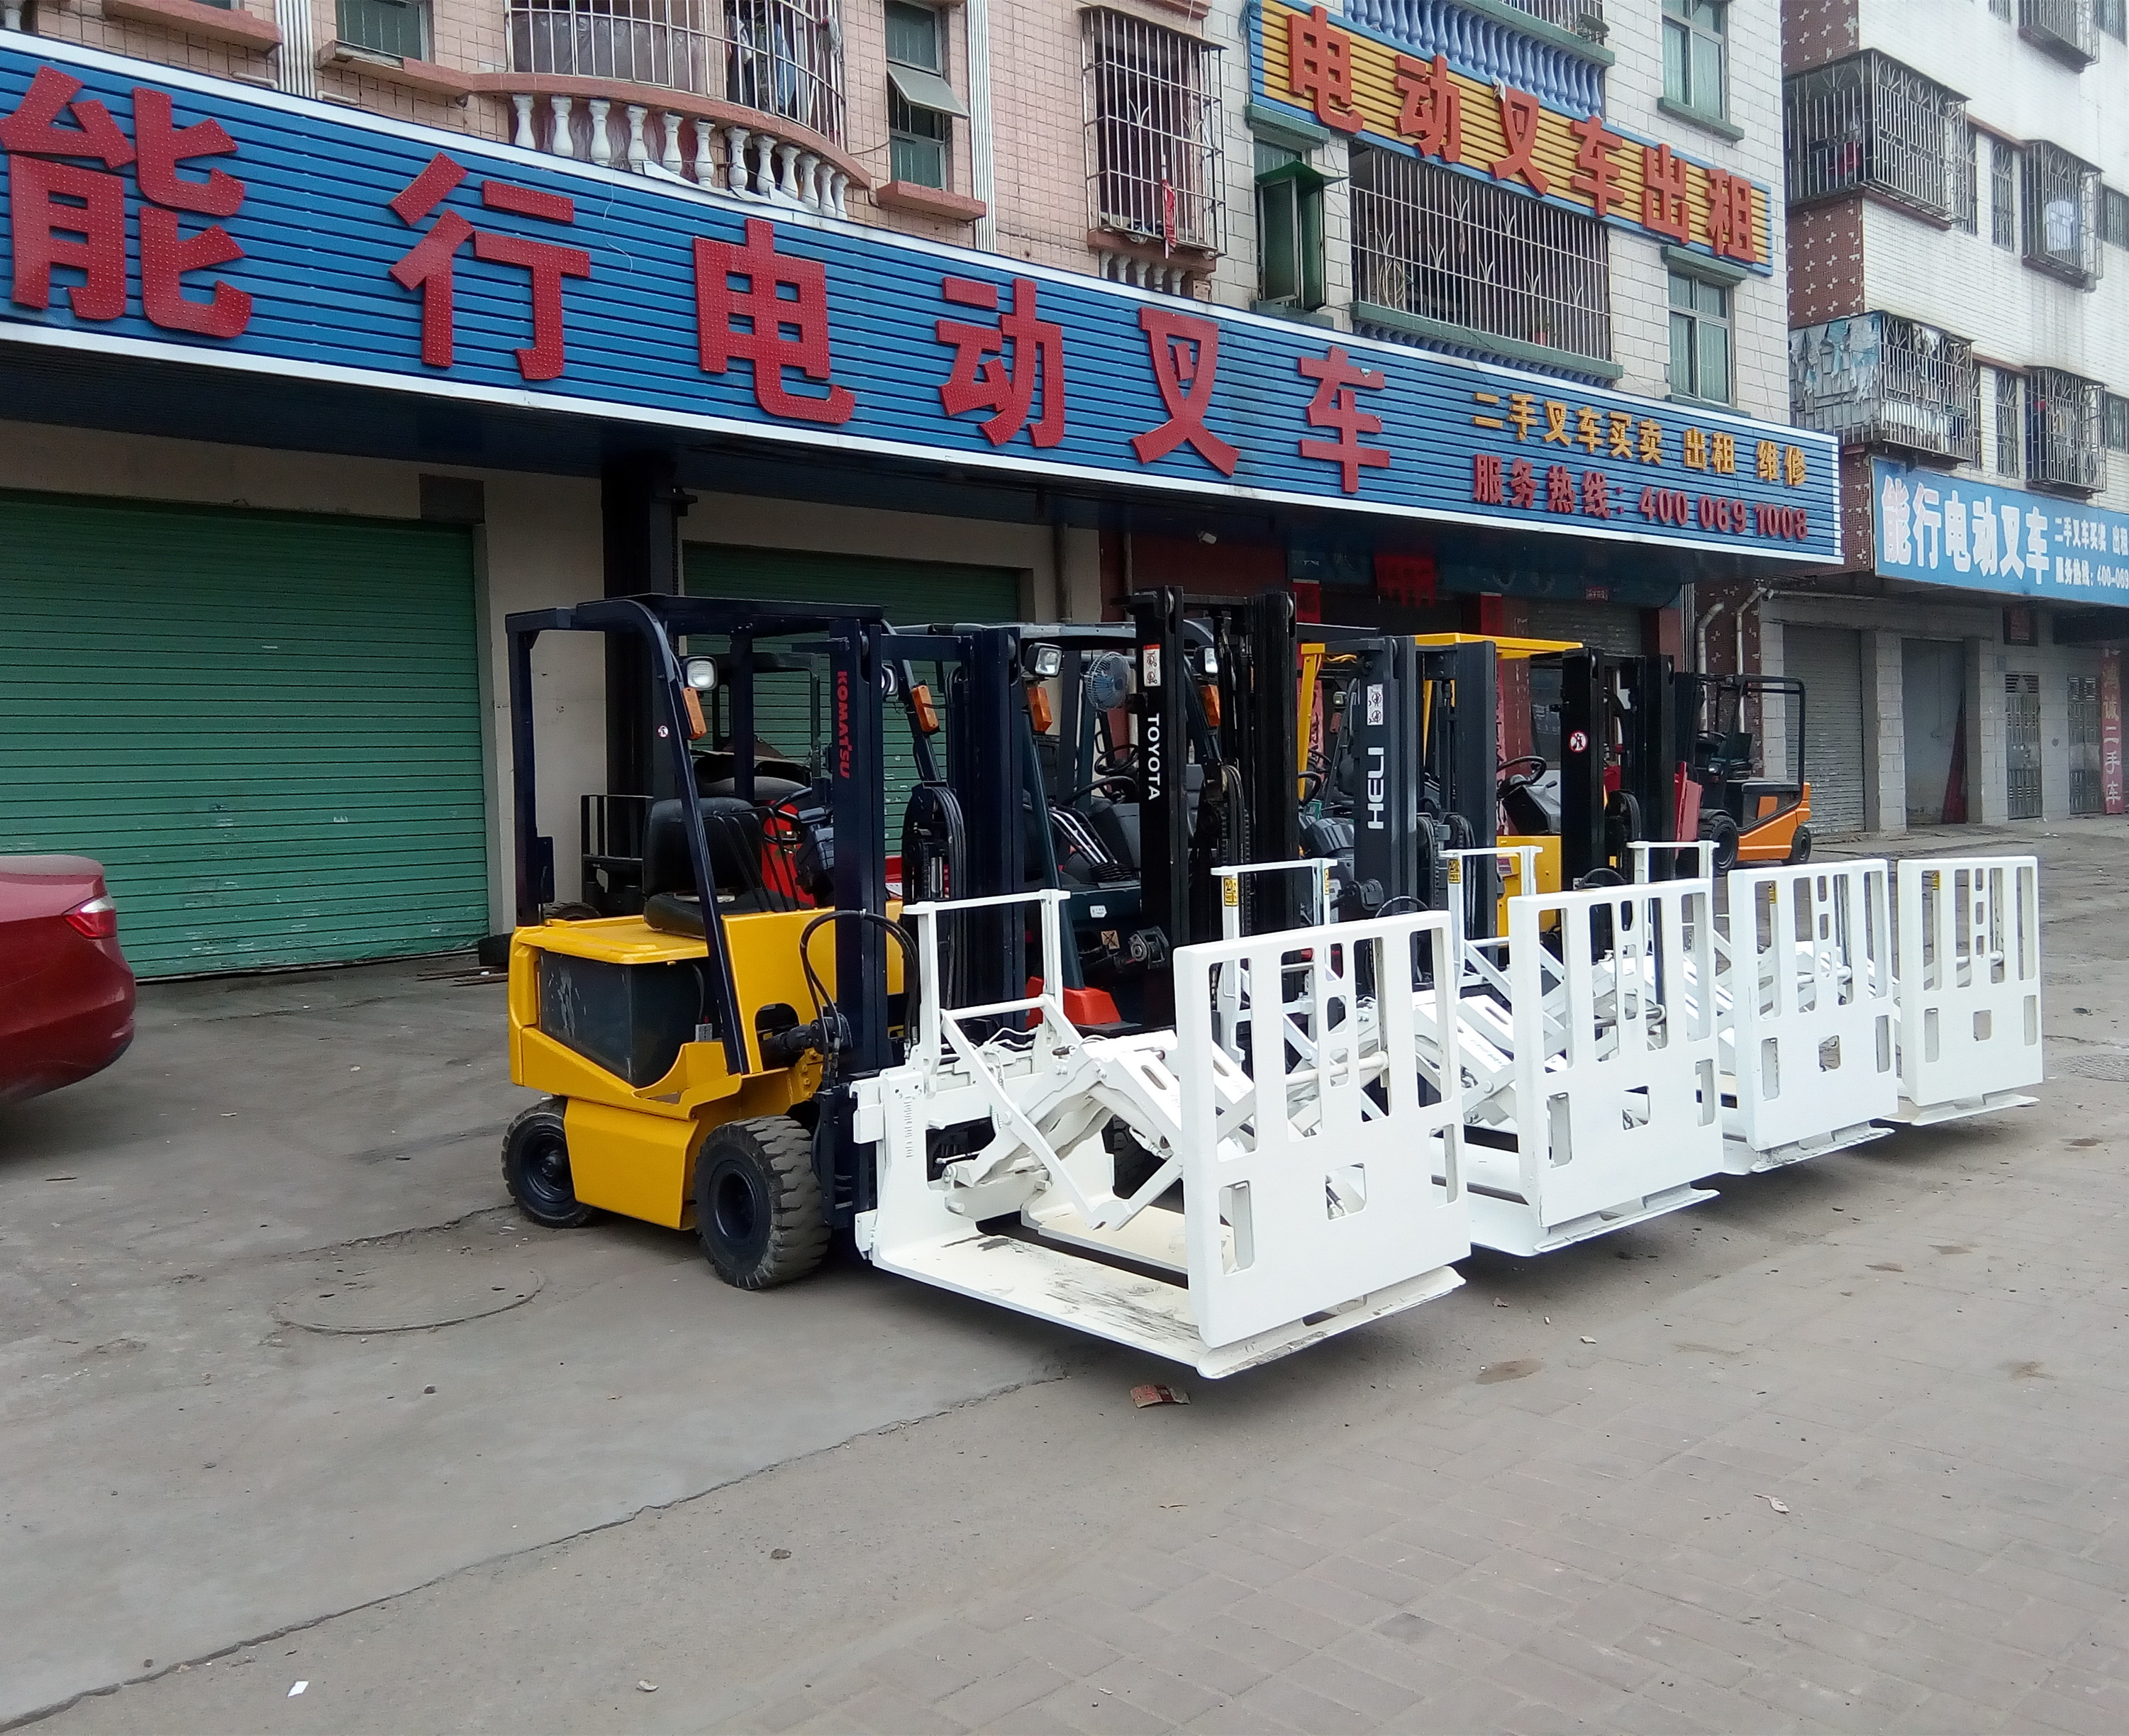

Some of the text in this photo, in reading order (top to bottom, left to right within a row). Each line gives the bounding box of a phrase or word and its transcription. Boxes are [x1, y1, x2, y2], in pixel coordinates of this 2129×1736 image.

[1286, 6, 1757, 263] 电动叉车出租
[0, 65, 1391, 495] 能行电动叉车
[1473, 392, 1807, 486] 二手叉车买卖 出租 维修
[1638, 486, 1689, 527] 400
[1698, 494, 1747, 533] 069
[1754, 502, 1808, 541] 1008
[1881, 474, 2050, 585] 能行电动叉车
[837, 670, 853, 779] KOMATSU
[1147, 713, 1161, 801] TOYOTA
[1367, 747, 1384, 830] HELI
